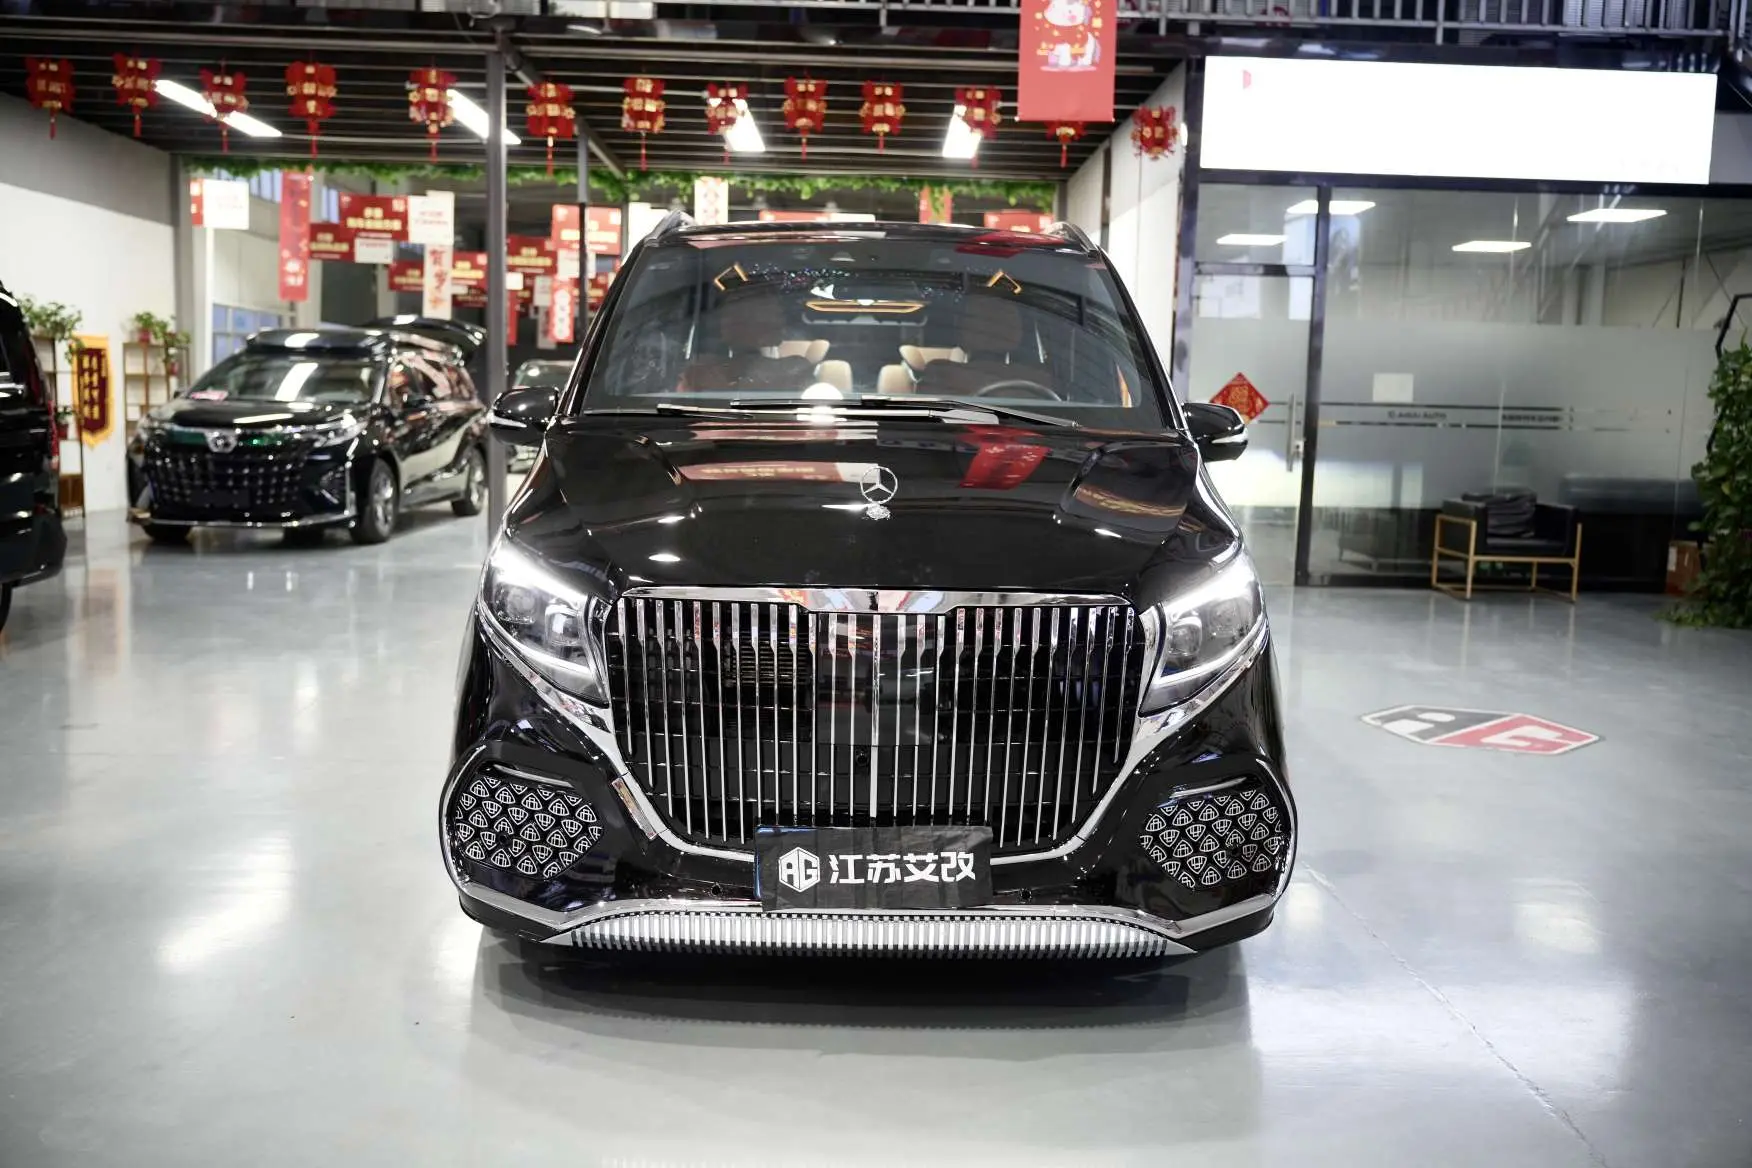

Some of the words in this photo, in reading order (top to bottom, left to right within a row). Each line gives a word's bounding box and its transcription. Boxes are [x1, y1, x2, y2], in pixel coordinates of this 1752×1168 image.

[780, 848, 820, 892] AG
[828, 851, 976, 884] 江苏艾改
